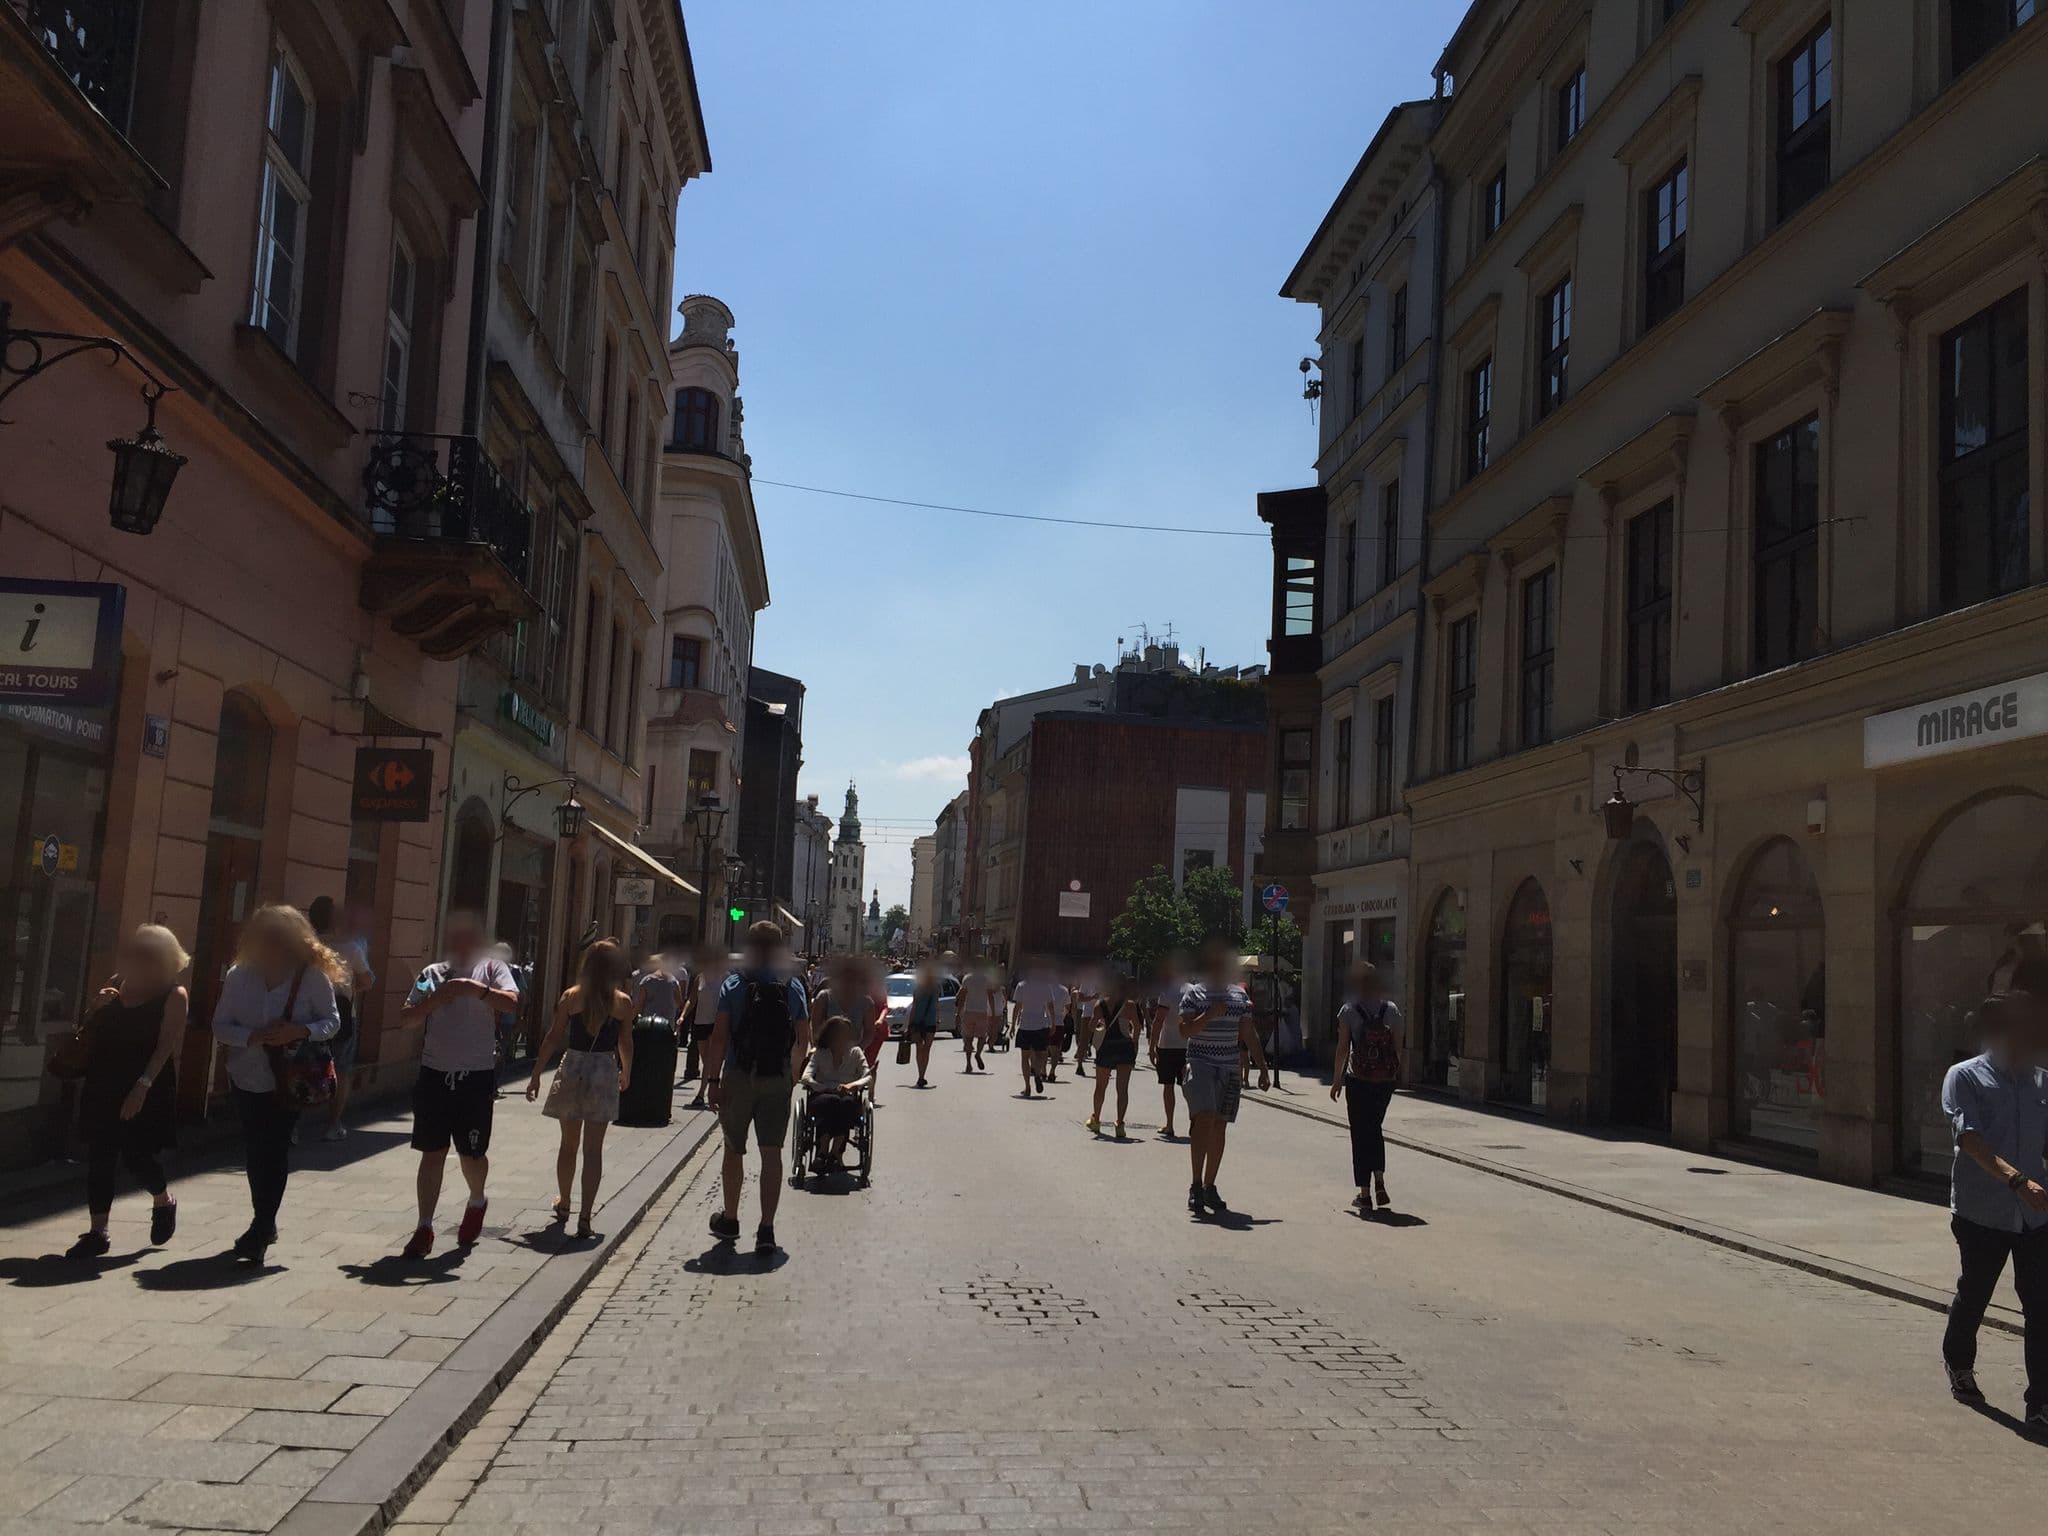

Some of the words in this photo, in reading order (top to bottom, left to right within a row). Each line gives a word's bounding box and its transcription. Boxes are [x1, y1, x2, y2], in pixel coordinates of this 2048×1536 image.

[20, 603, 45, 652] i
[27, 674, 79, 690] TOURS
[8, 704, 74, 732] INFORMATION
[76, 719, 104, 741] POINT
[1918, 692, 2018, 747] MIRAGE
